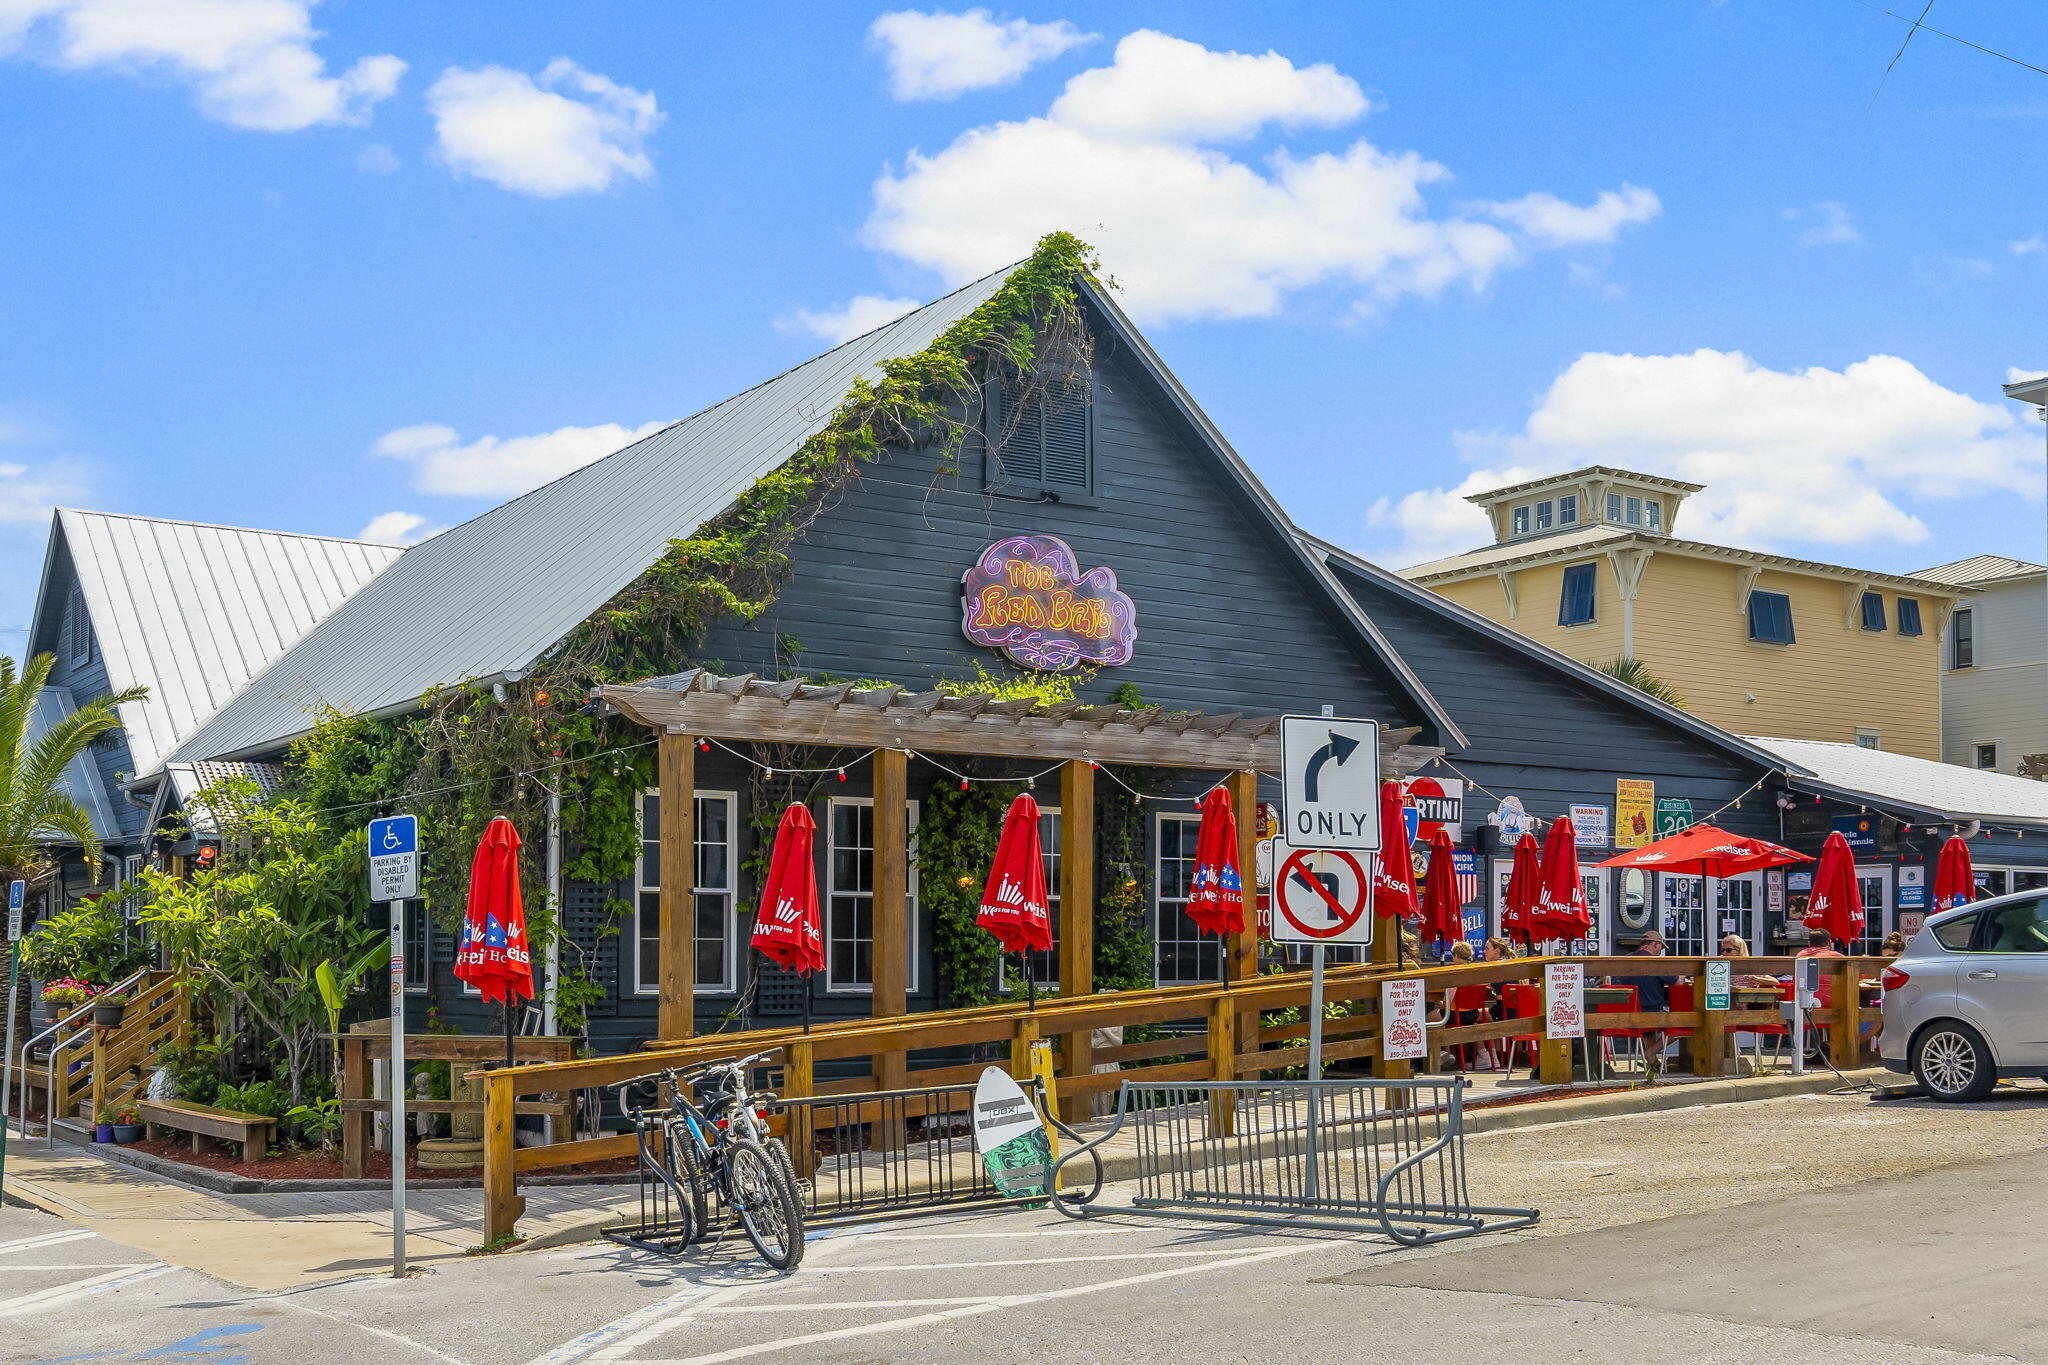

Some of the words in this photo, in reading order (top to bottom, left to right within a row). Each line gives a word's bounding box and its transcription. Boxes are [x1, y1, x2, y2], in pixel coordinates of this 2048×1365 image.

[1416, 798, 1459, 820] RTINI
[1575, 807, 1604, 816] WARNING
[1297, 810, 1367, 837] ONLY
[373, 857, 401, 867] PARKING
[403, 855, 413, 864] BY
[377, 865, 409, 877] DISABLED
[1454, 862, 1474, 871] ACIFIC
[381, 874, 405, 885] PERMIT
[385, 884, 402, 894] ONLY
[1906, 917, 1918, 926] NO
[1391, 981, 1417, 989] PARKING
[1390, 991, 1400, 999] FOR
[1402, 990, 1419, 998] TO-GO
[1393, 999, 1416, 1008] ORDERS
